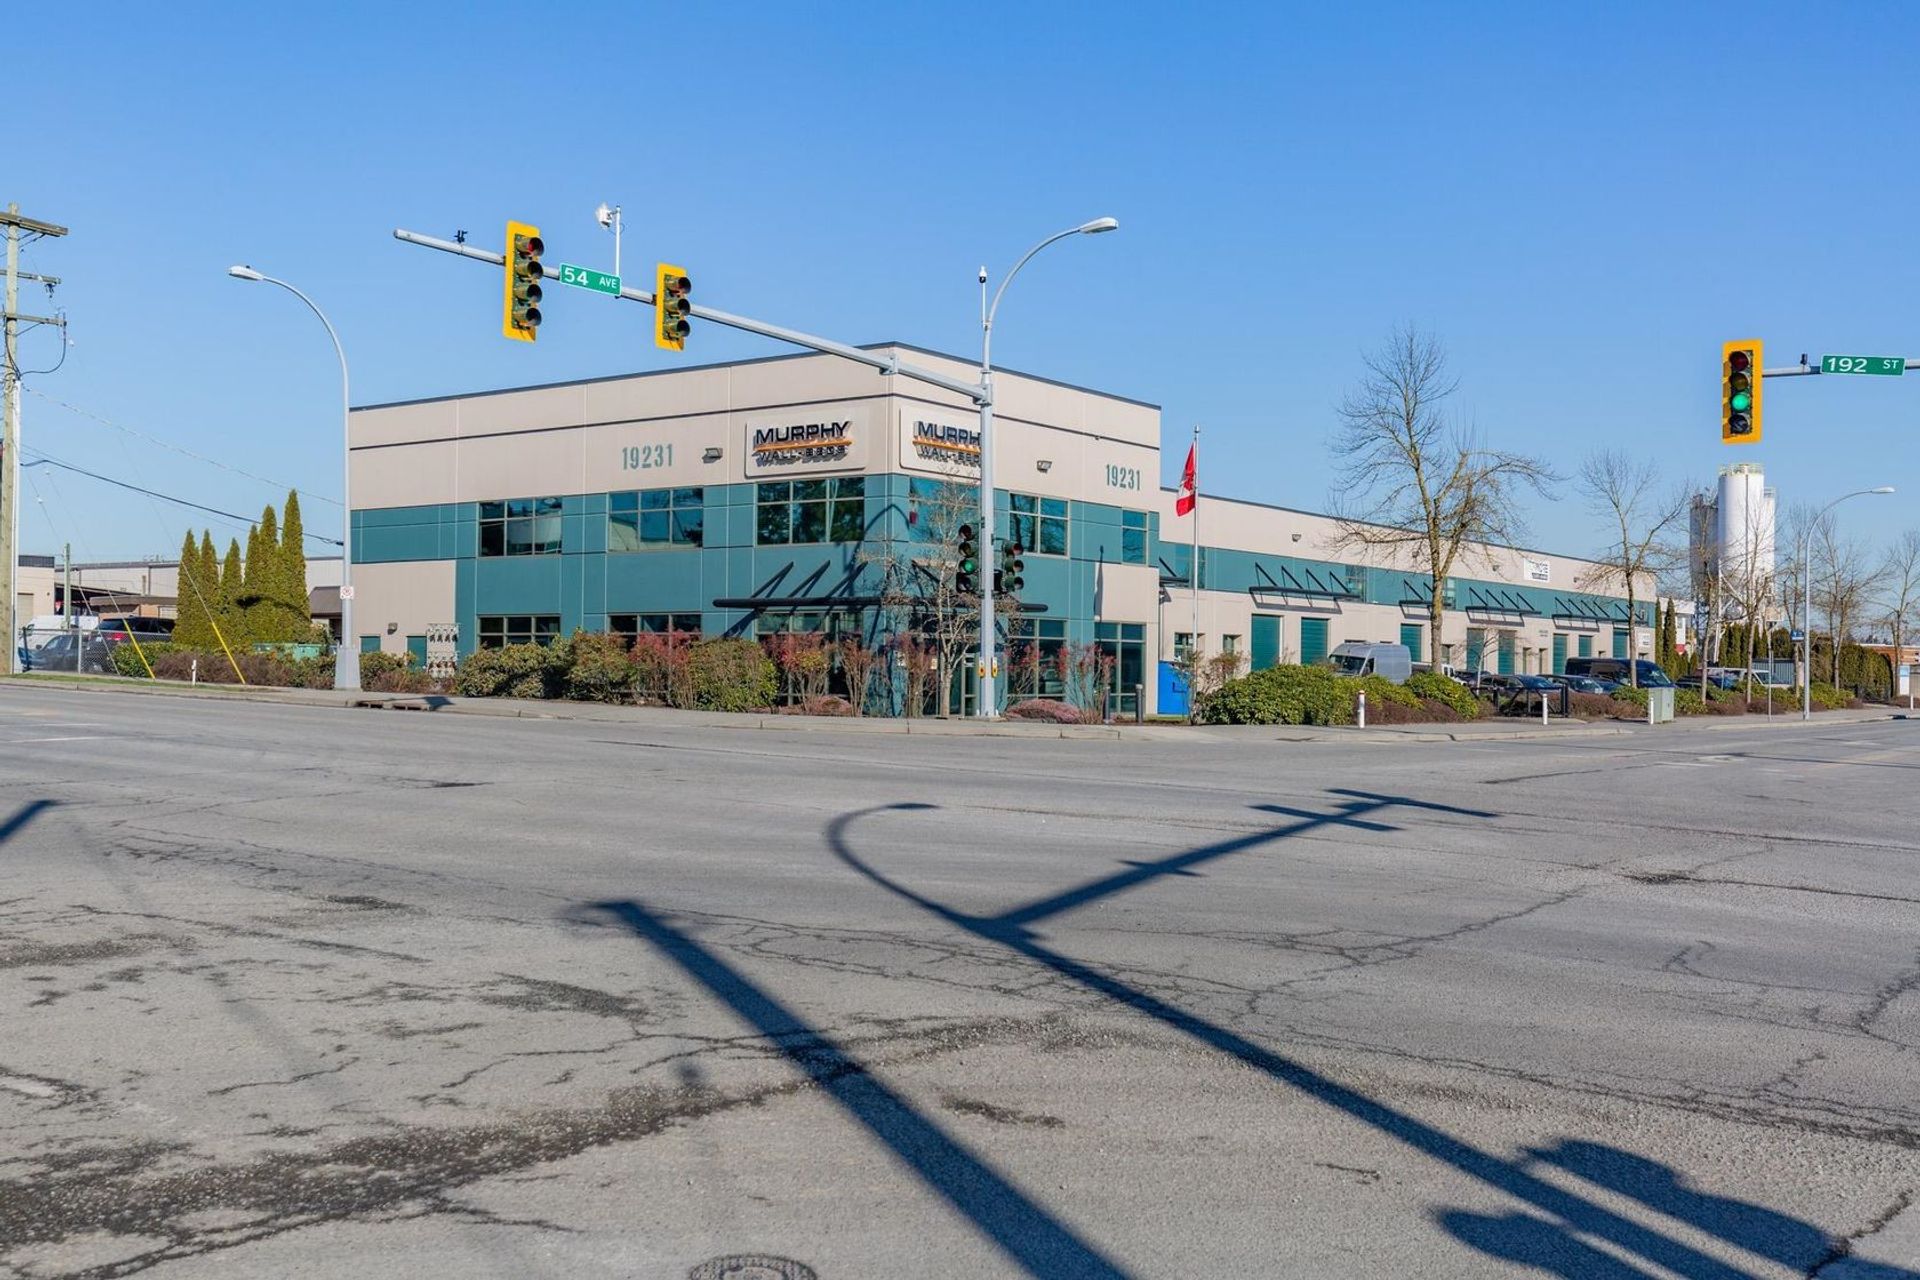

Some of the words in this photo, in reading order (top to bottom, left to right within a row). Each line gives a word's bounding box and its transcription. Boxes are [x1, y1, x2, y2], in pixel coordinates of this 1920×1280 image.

[564, 267, 589, 286] 54
[599, 277, 617, 289] AVE
[1827, 357, 1868, 373] 192
[1882, 359, 1899, 370] ST
[756, 421, 850, 444] MURPHY
[918, 420, 981, 446] MURPH
[622, 443, 673, 470] 19231
[920, 444, 981, 464] WALL-BED
[1106, 464, 1141, 491] 19231
